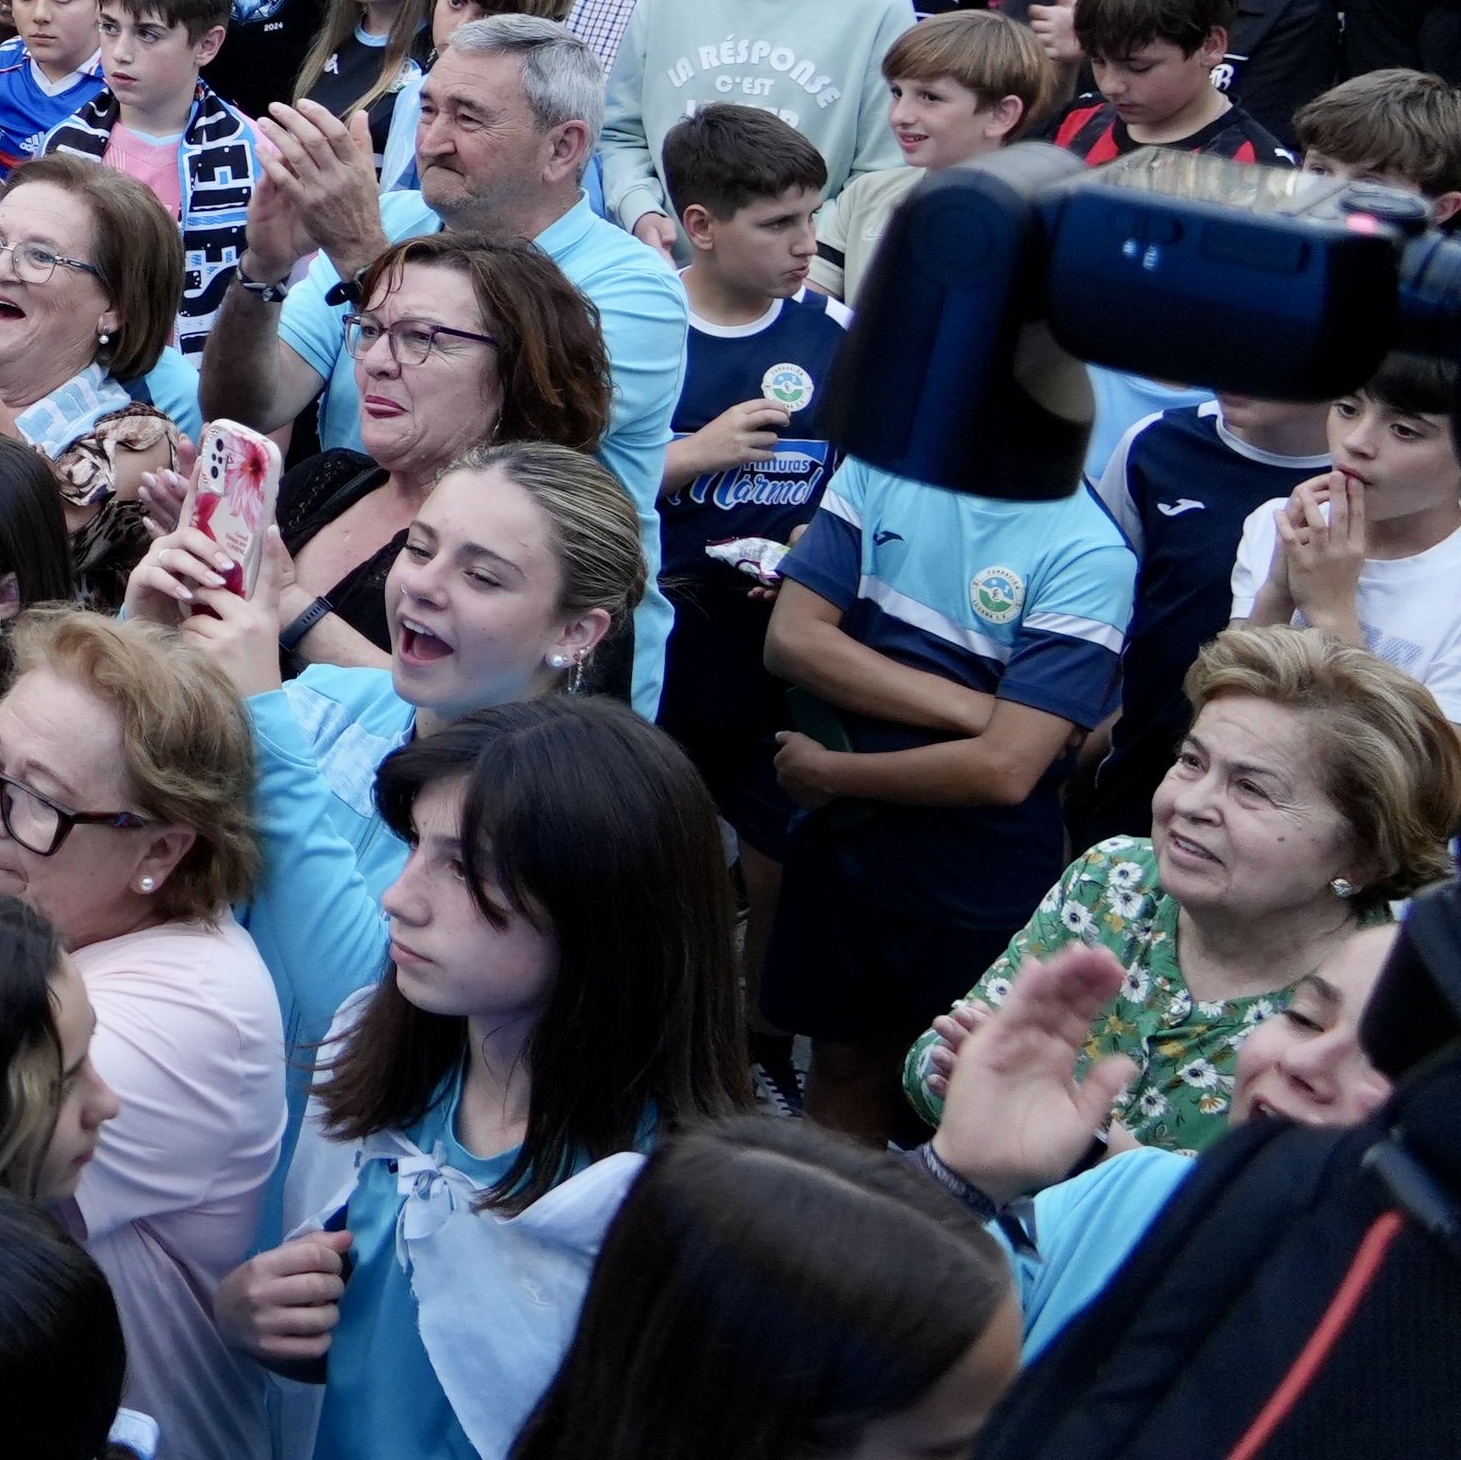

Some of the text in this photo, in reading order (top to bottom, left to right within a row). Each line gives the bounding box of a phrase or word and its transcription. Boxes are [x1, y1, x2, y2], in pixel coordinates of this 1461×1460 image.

[264, 22, 283, 32] 2024
[698, 34, 842, 109] RÉSPONSE
[715, 75, 775, 96] C'EST
